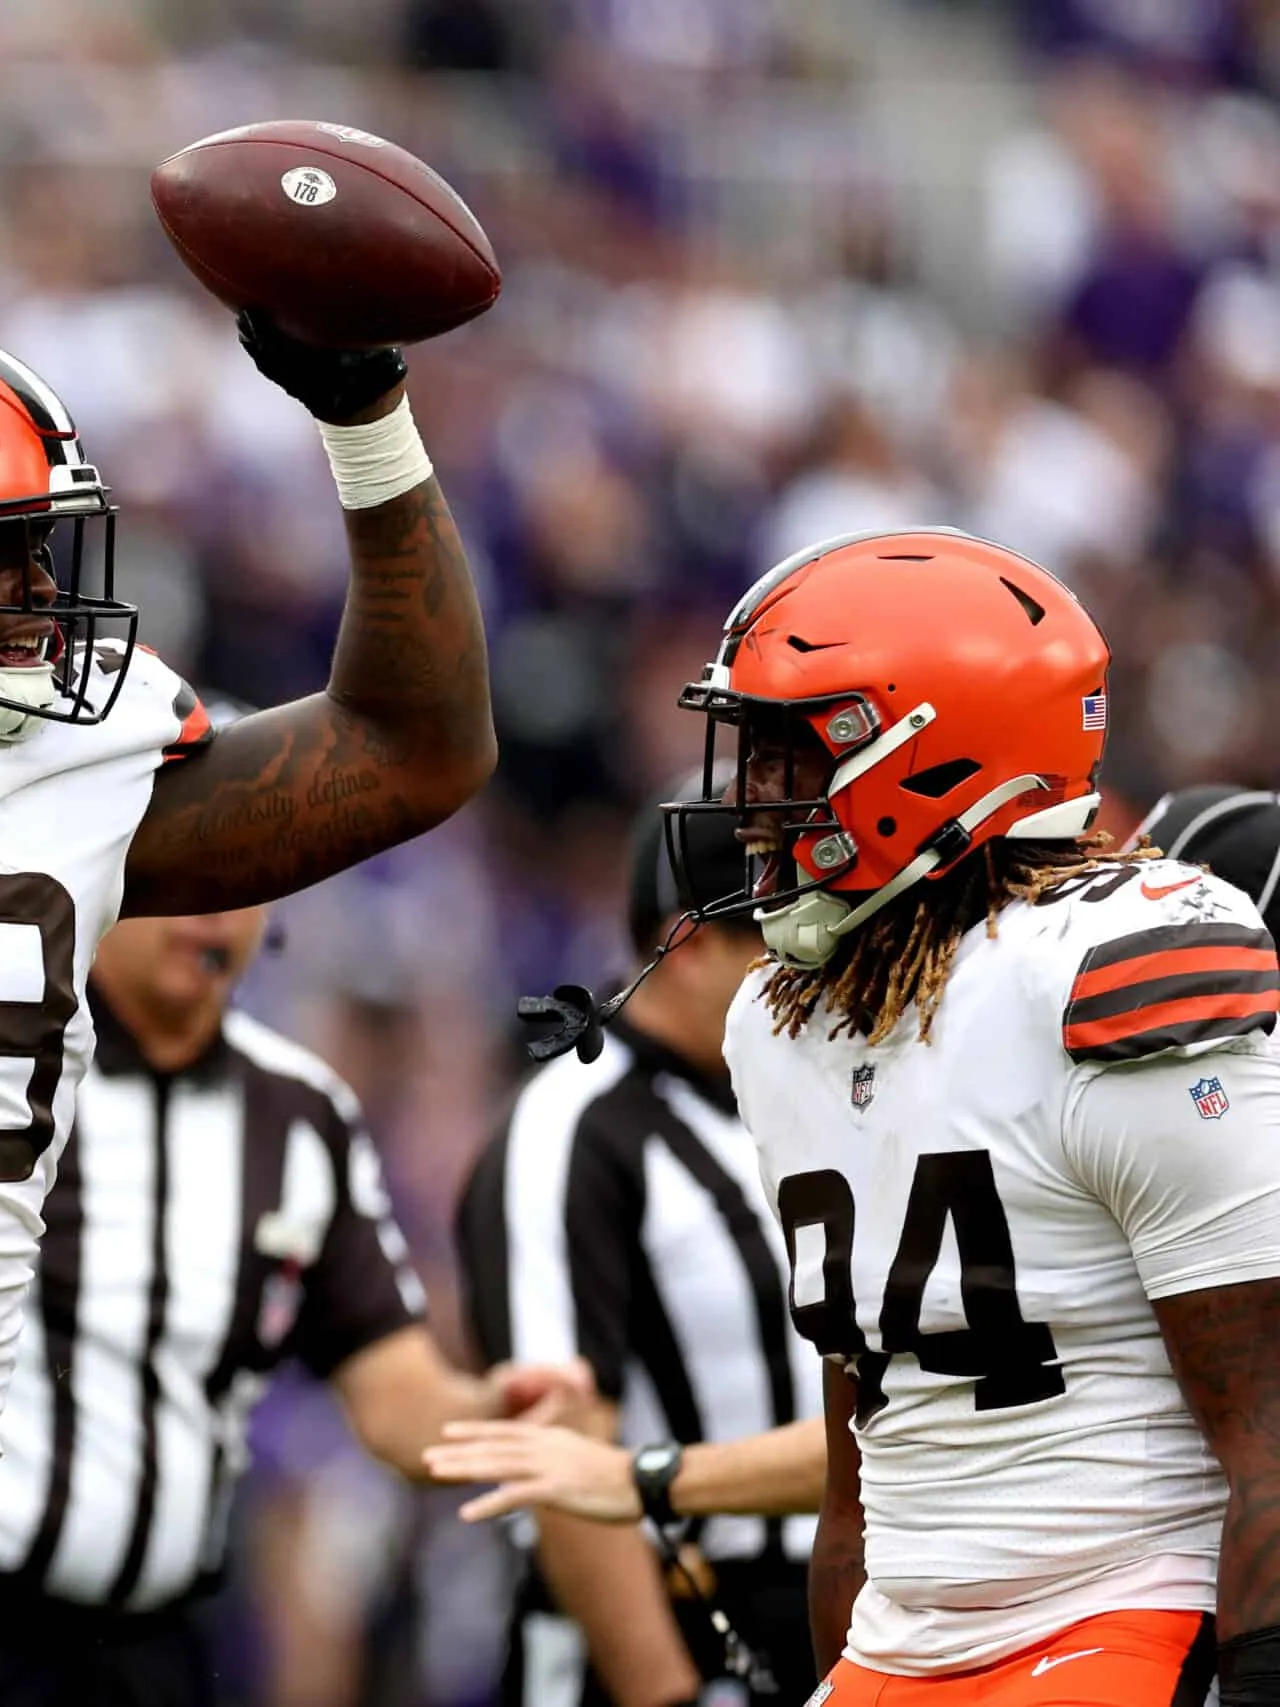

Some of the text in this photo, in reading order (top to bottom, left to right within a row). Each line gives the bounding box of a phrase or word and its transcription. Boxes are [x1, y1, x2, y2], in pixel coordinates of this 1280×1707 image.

[294, 181, 319, 202] 178
[1197, 1092, 1226, 1116] NFL
[778, 1149, 1066, 1430] 94
